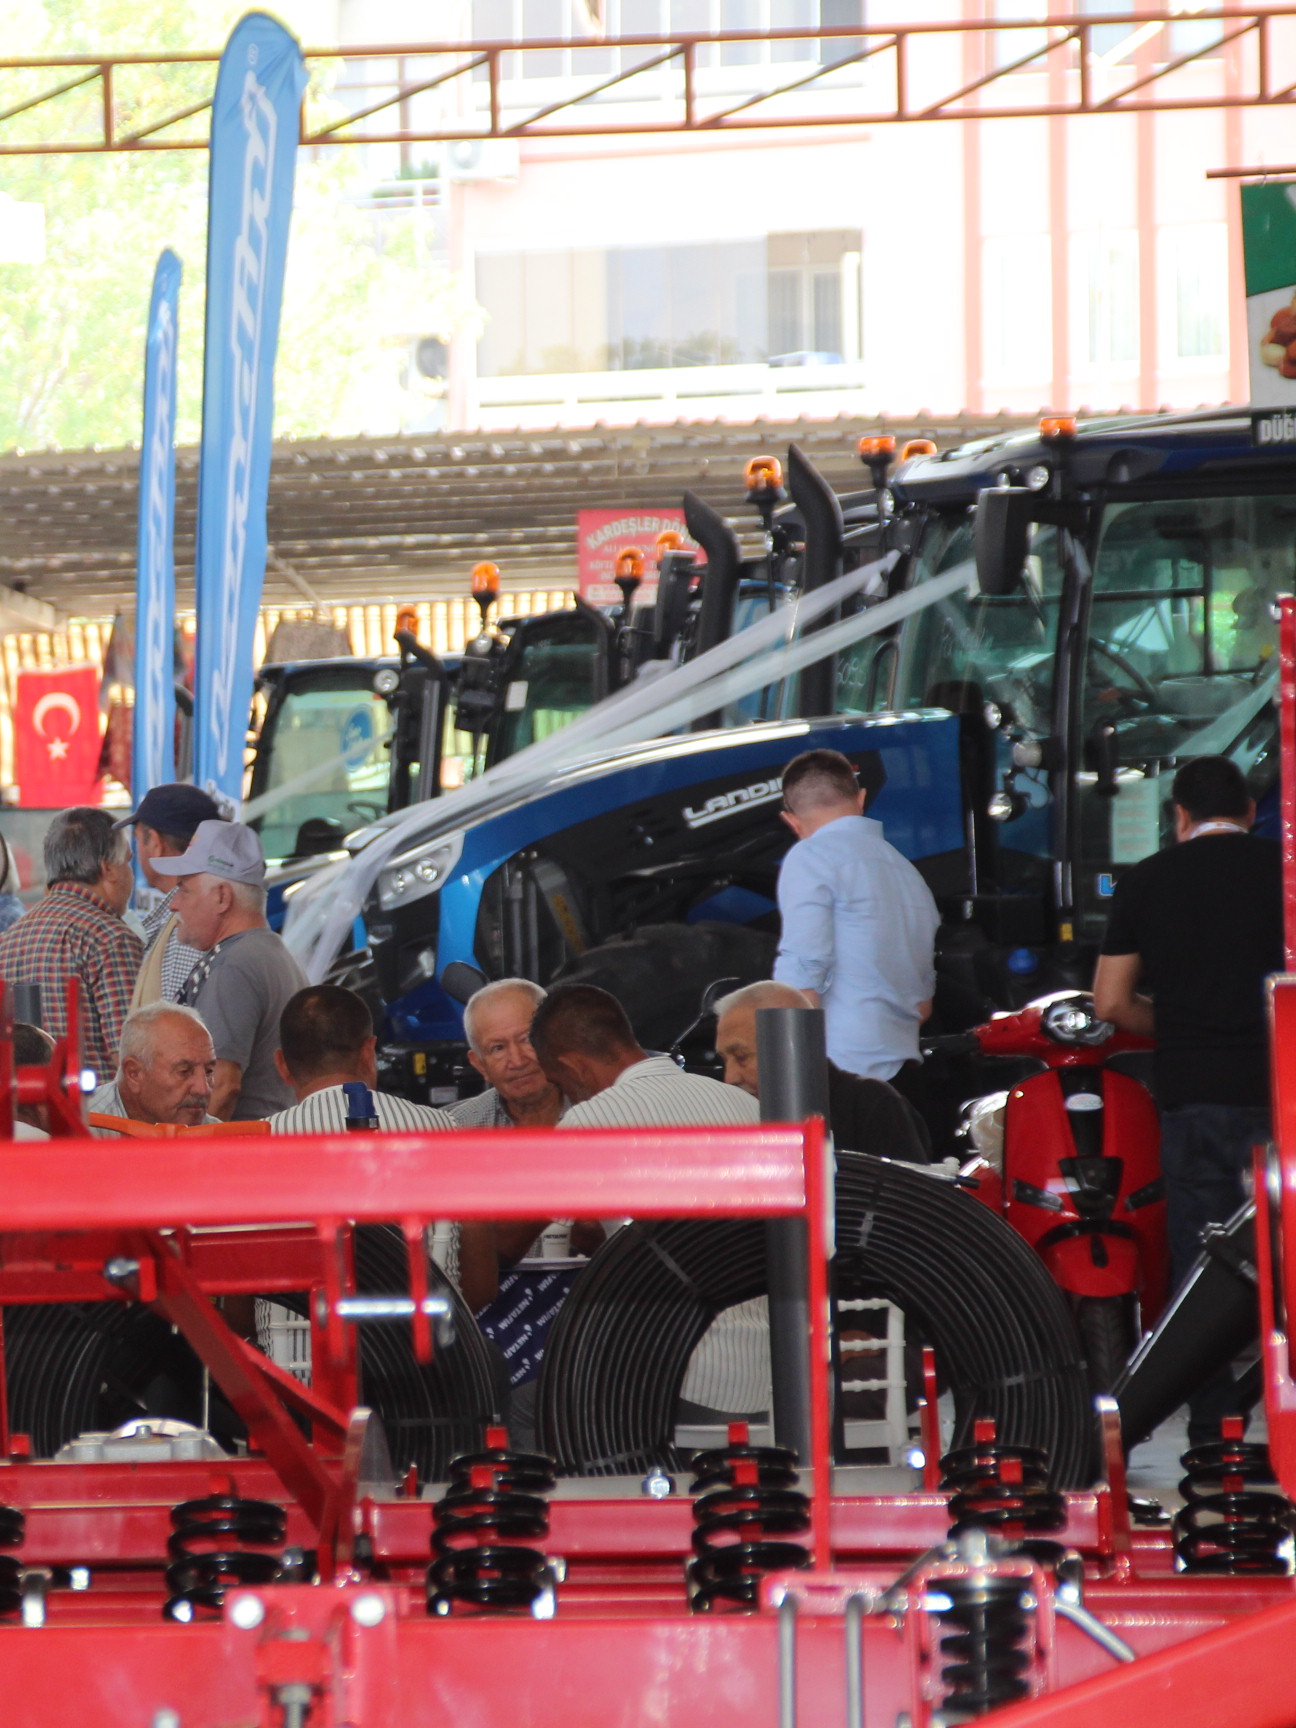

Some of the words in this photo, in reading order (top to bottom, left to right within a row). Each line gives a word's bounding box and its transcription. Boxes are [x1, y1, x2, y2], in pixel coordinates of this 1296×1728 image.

[1259, 413, 1296, 442] DÜĞ
[586, 516, 661, 550] KARDEŞLER
[498, 1298, 531, 1331] NETAFIM
[504, 1333, 529, 1359] NETAFI
